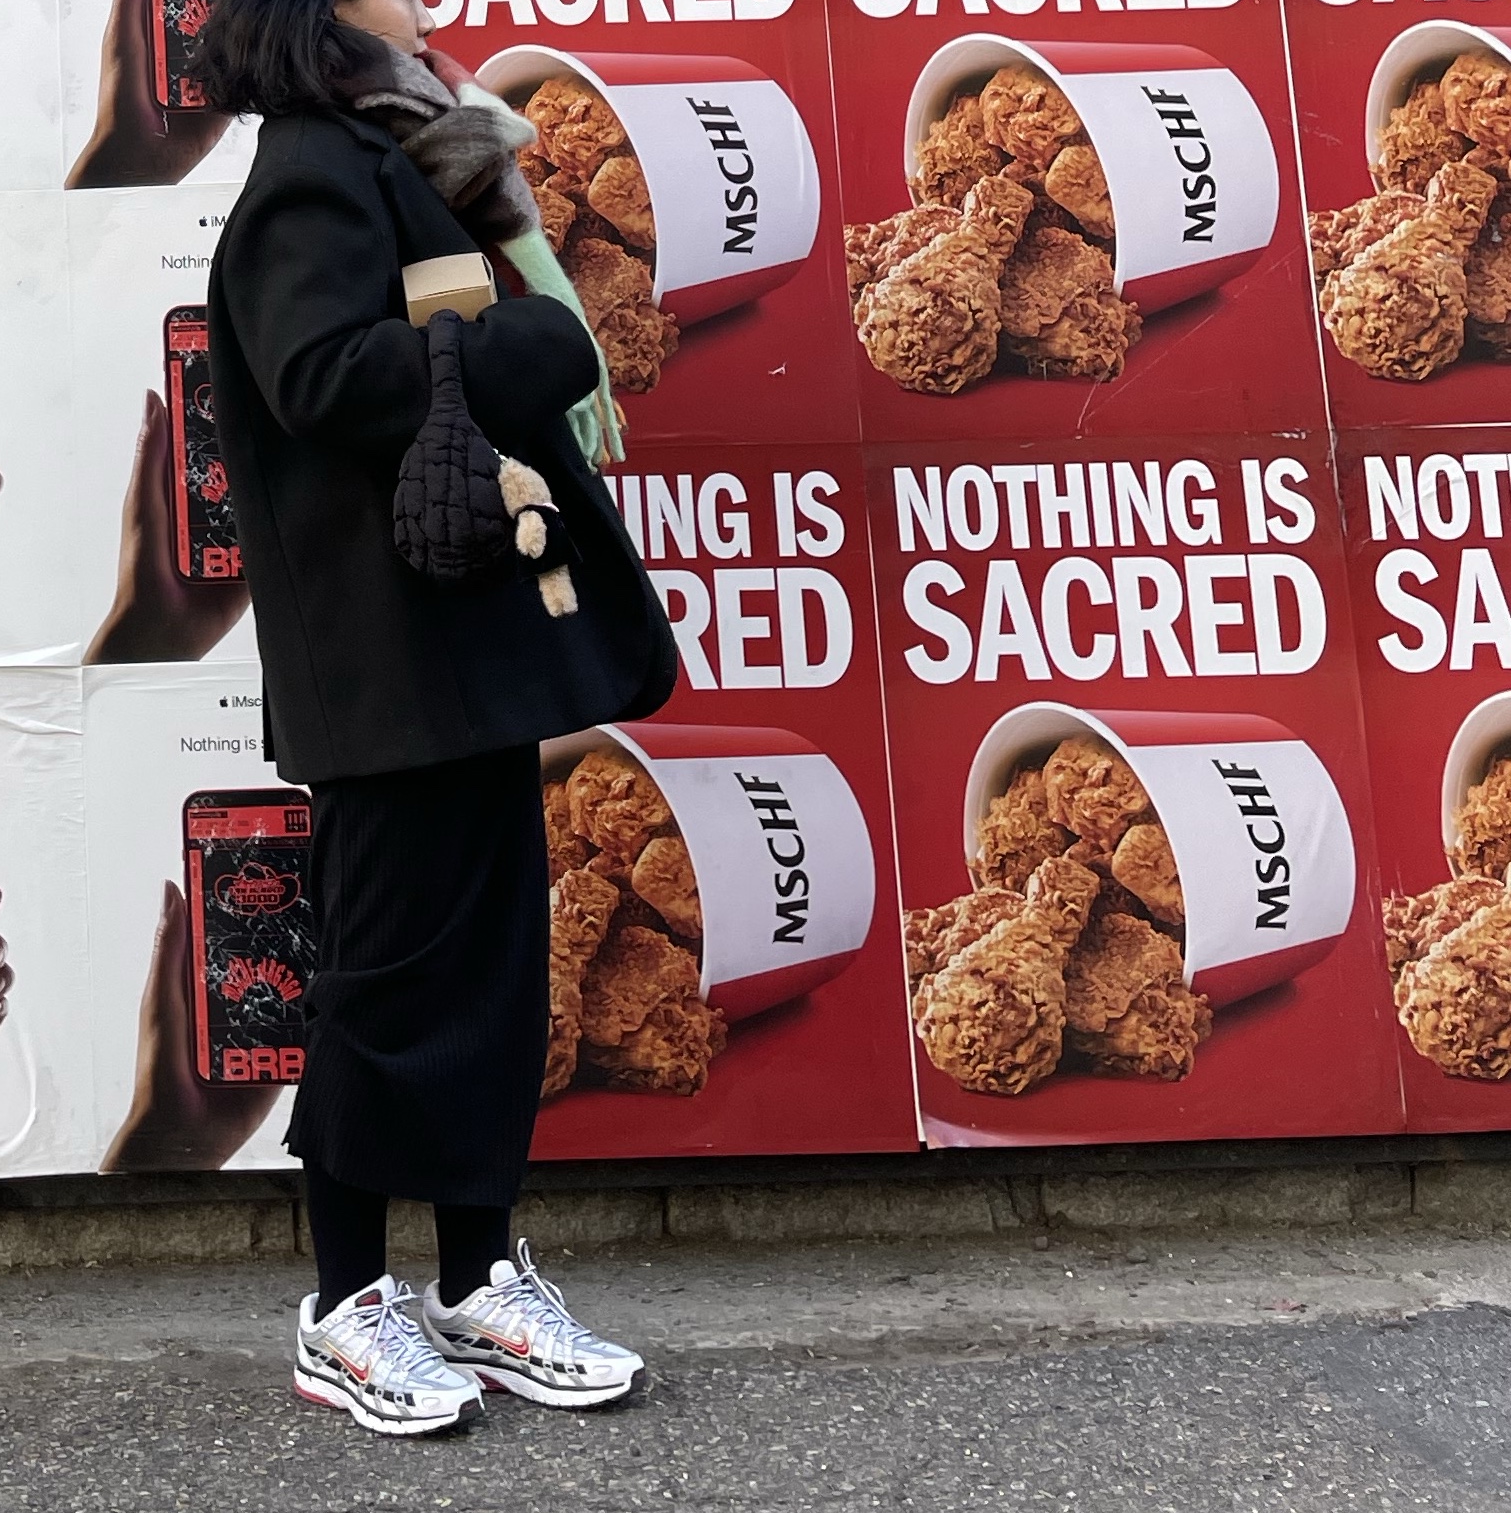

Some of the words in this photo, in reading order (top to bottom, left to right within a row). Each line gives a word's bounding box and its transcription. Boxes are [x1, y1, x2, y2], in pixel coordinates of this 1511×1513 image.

[686, 97, 758, 255] MSCHF
[1140, 85, 1216, 244] MSCHF
[773, 471, 845, 558] IS
[896, 459, 1221, 551] NOTHING
[1240, 457, 1316, 544] IS
[902, 554, 1327, 685] SACRED
[180, 737, 240, 754] Nothing
[243, 735, 257, 750] is
[734, 772, 810, 944] MSCHF
[1212, 759, 1290, 929] MSCHF
[222, 1047, 306, 1081] BRB
